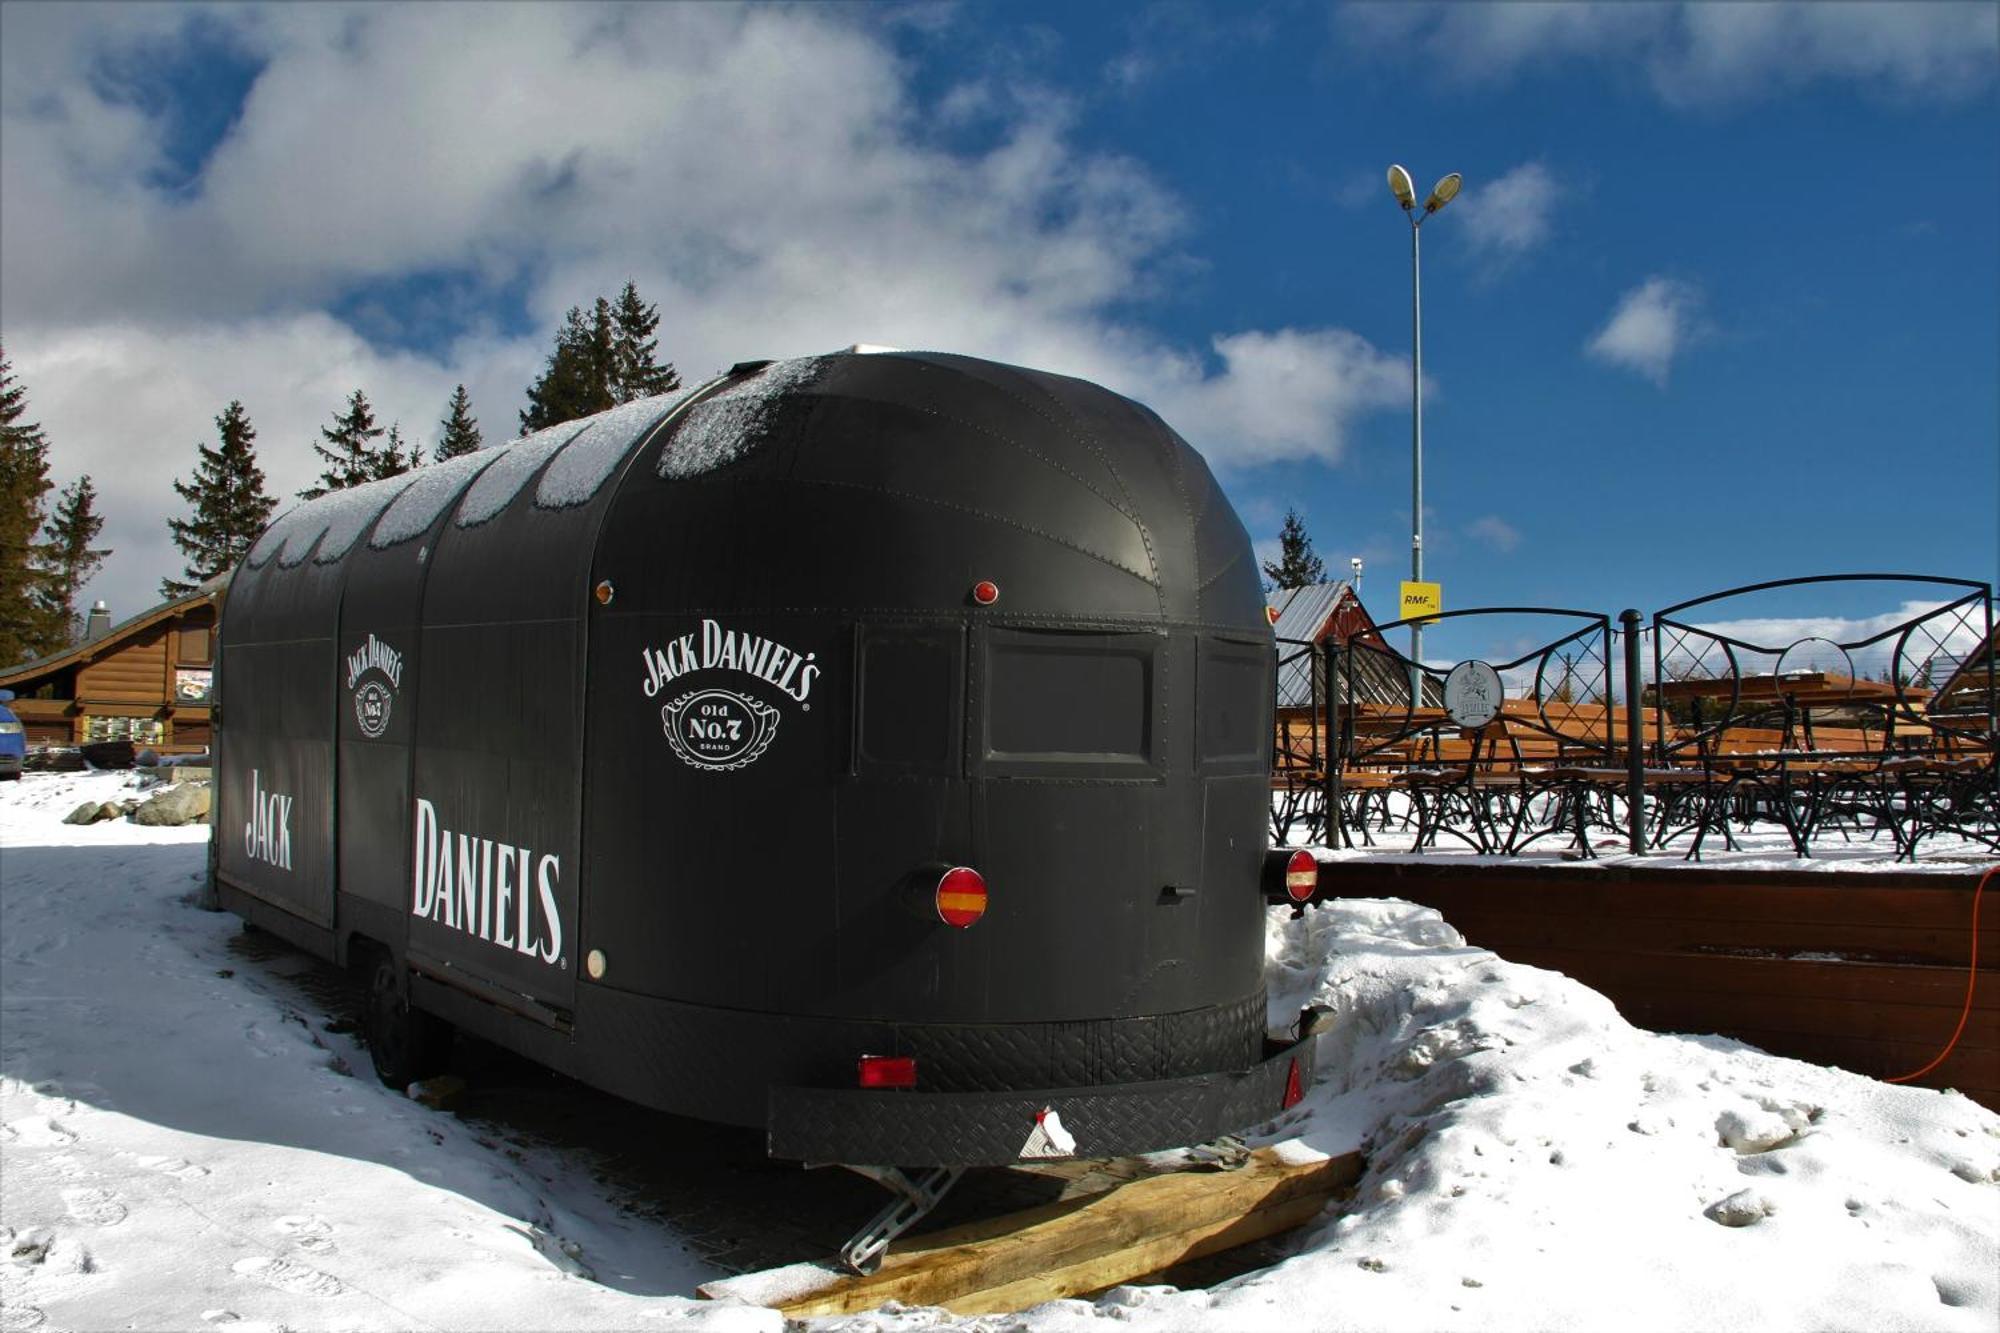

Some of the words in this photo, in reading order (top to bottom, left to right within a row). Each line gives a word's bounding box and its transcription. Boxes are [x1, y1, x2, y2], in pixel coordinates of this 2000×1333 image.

[1404, 595, 1429, 605] RMF
[347, 643, 368, 689] JACK
[642, 633, 700, 697] JACK
[702, 618, 821, 702] DANIEL'S
[700, 743, 731, 752] BRAND
[246, 769, 292, 871] JACK
[412, 798, 562, 965] DANIELS
